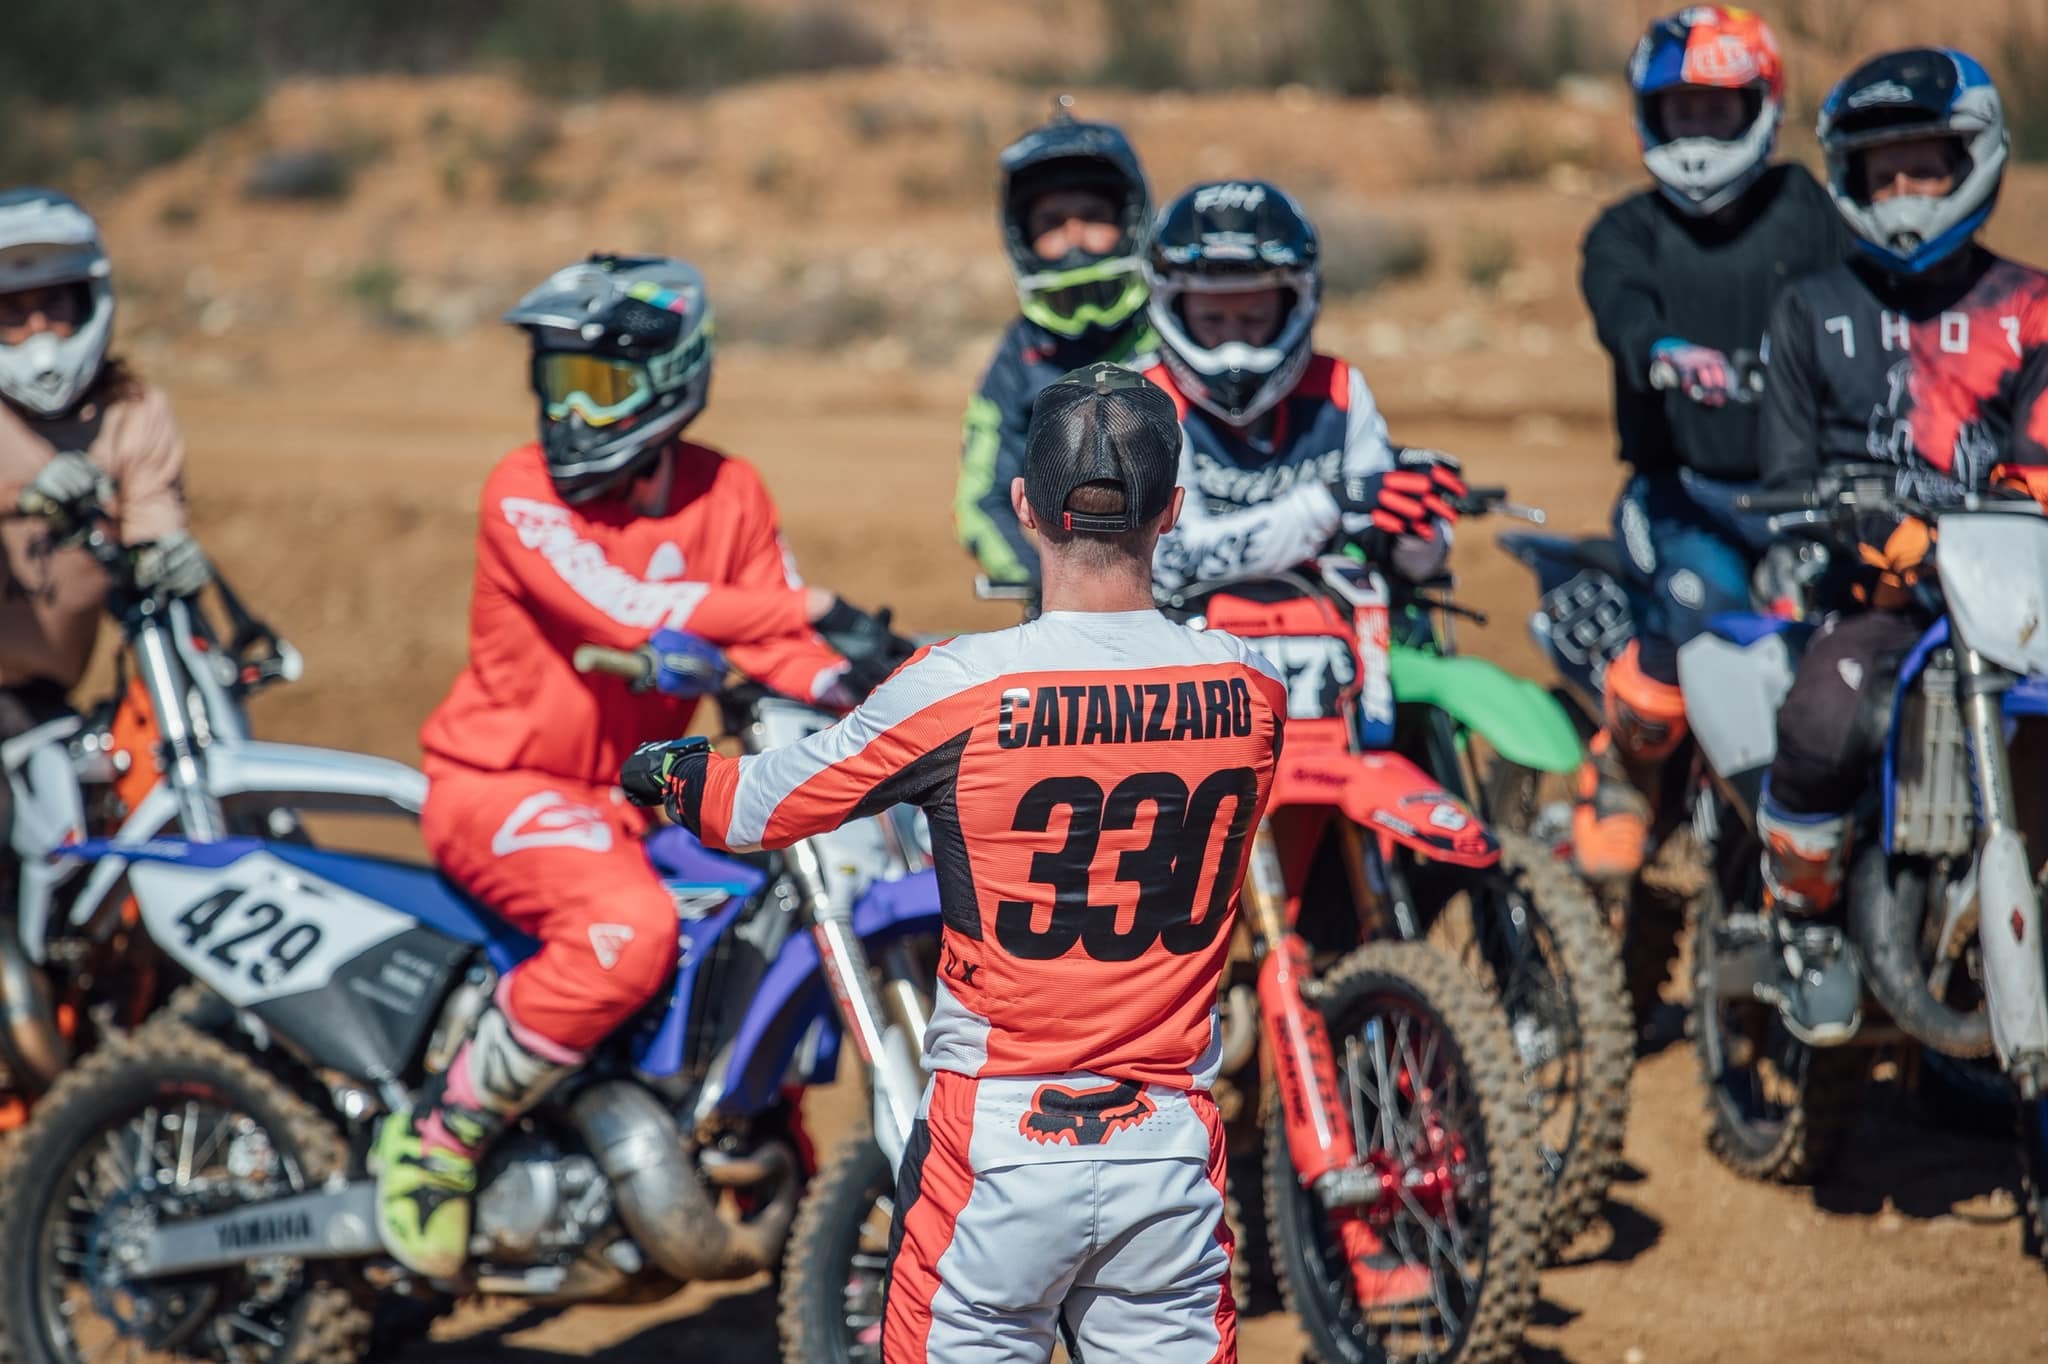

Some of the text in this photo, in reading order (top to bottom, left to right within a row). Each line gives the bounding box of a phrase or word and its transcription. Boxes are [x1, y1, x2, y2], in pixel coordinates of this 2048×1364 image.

[998, 678, 1252, 749] CATANZARO
[995, 767, 1258, 963] 330
[176, 887, 321, 985] 429
[216, 1211, 311, 1249] YAMAHA
